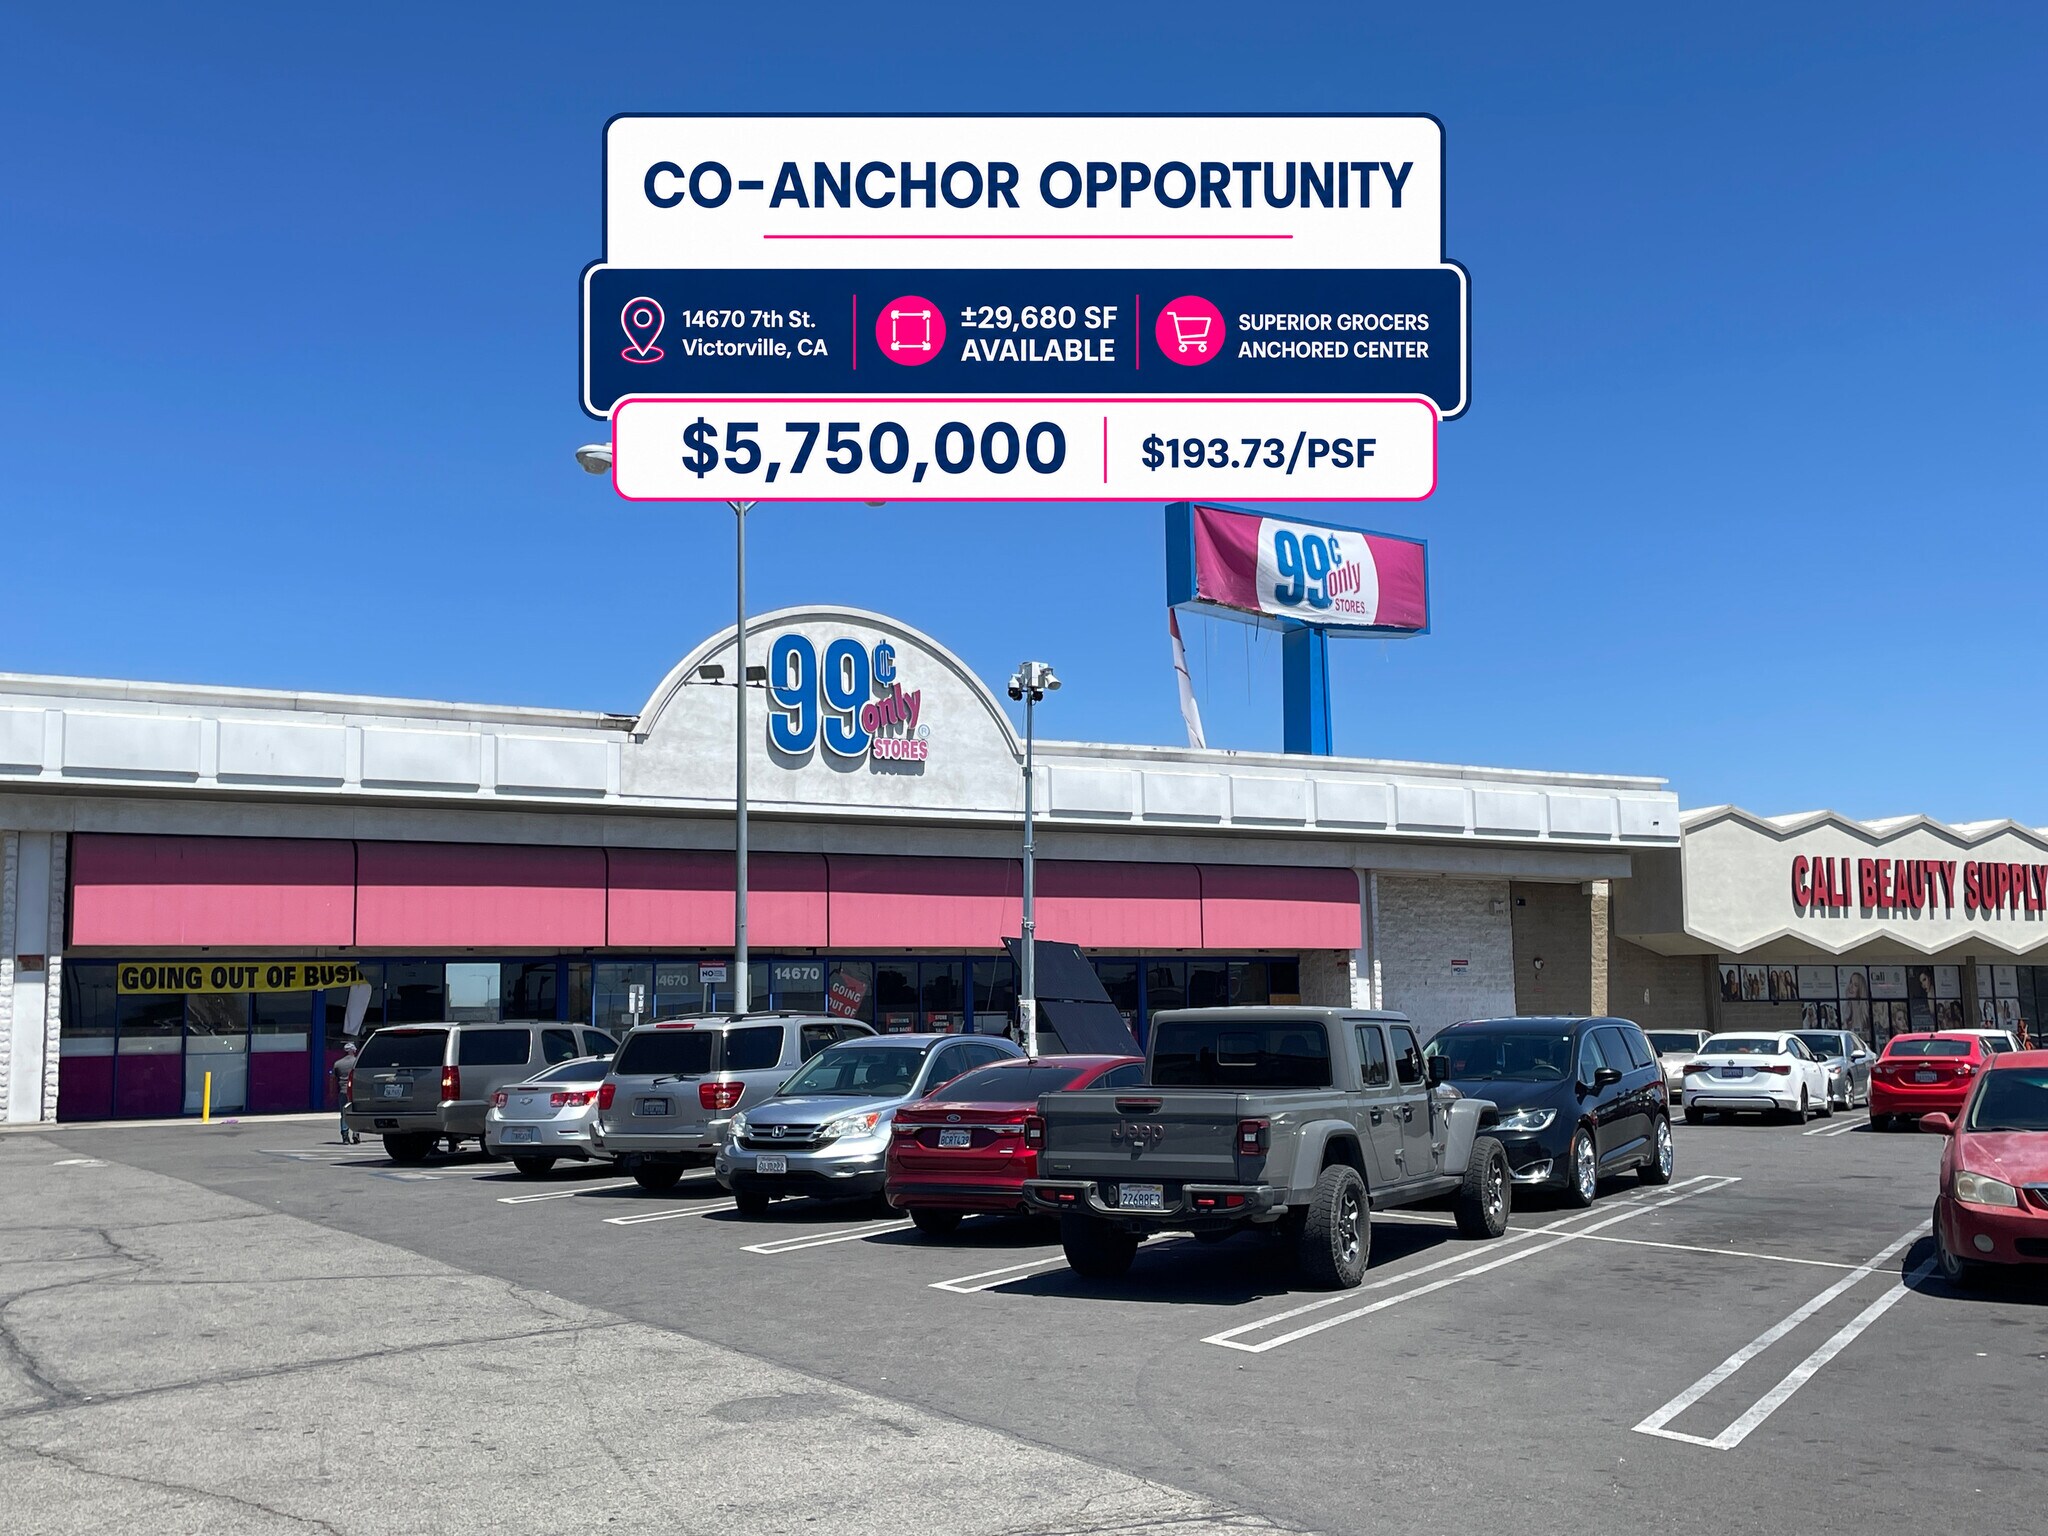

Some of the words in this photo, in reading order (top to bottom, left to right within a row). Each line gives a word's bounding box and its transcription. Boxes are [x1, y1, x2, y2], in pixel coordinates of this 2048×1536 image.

[1328, 560, 1361, 597] only
[1335, 598, 1365, 614] STORES
[862, 682, 921, 732] only
[873, 738, 928, 760] STORES
[1791, 855, 1852, 908] CALI
[1858, 858, 1957, 909] BEAUTY
[1964, 860, 2048, 911] SUPPLY
[121, 966, 203, 990] GOING
[210, 965, 259, 989] OUT
[266, 965, 297, 988] OF
[774, 967, 820, 980] 14670
[832, 982, 861, 1003] GOING
[844, 1005, 857, 1017] OF
[1112, 1119, 1165, 1144] Jeep
